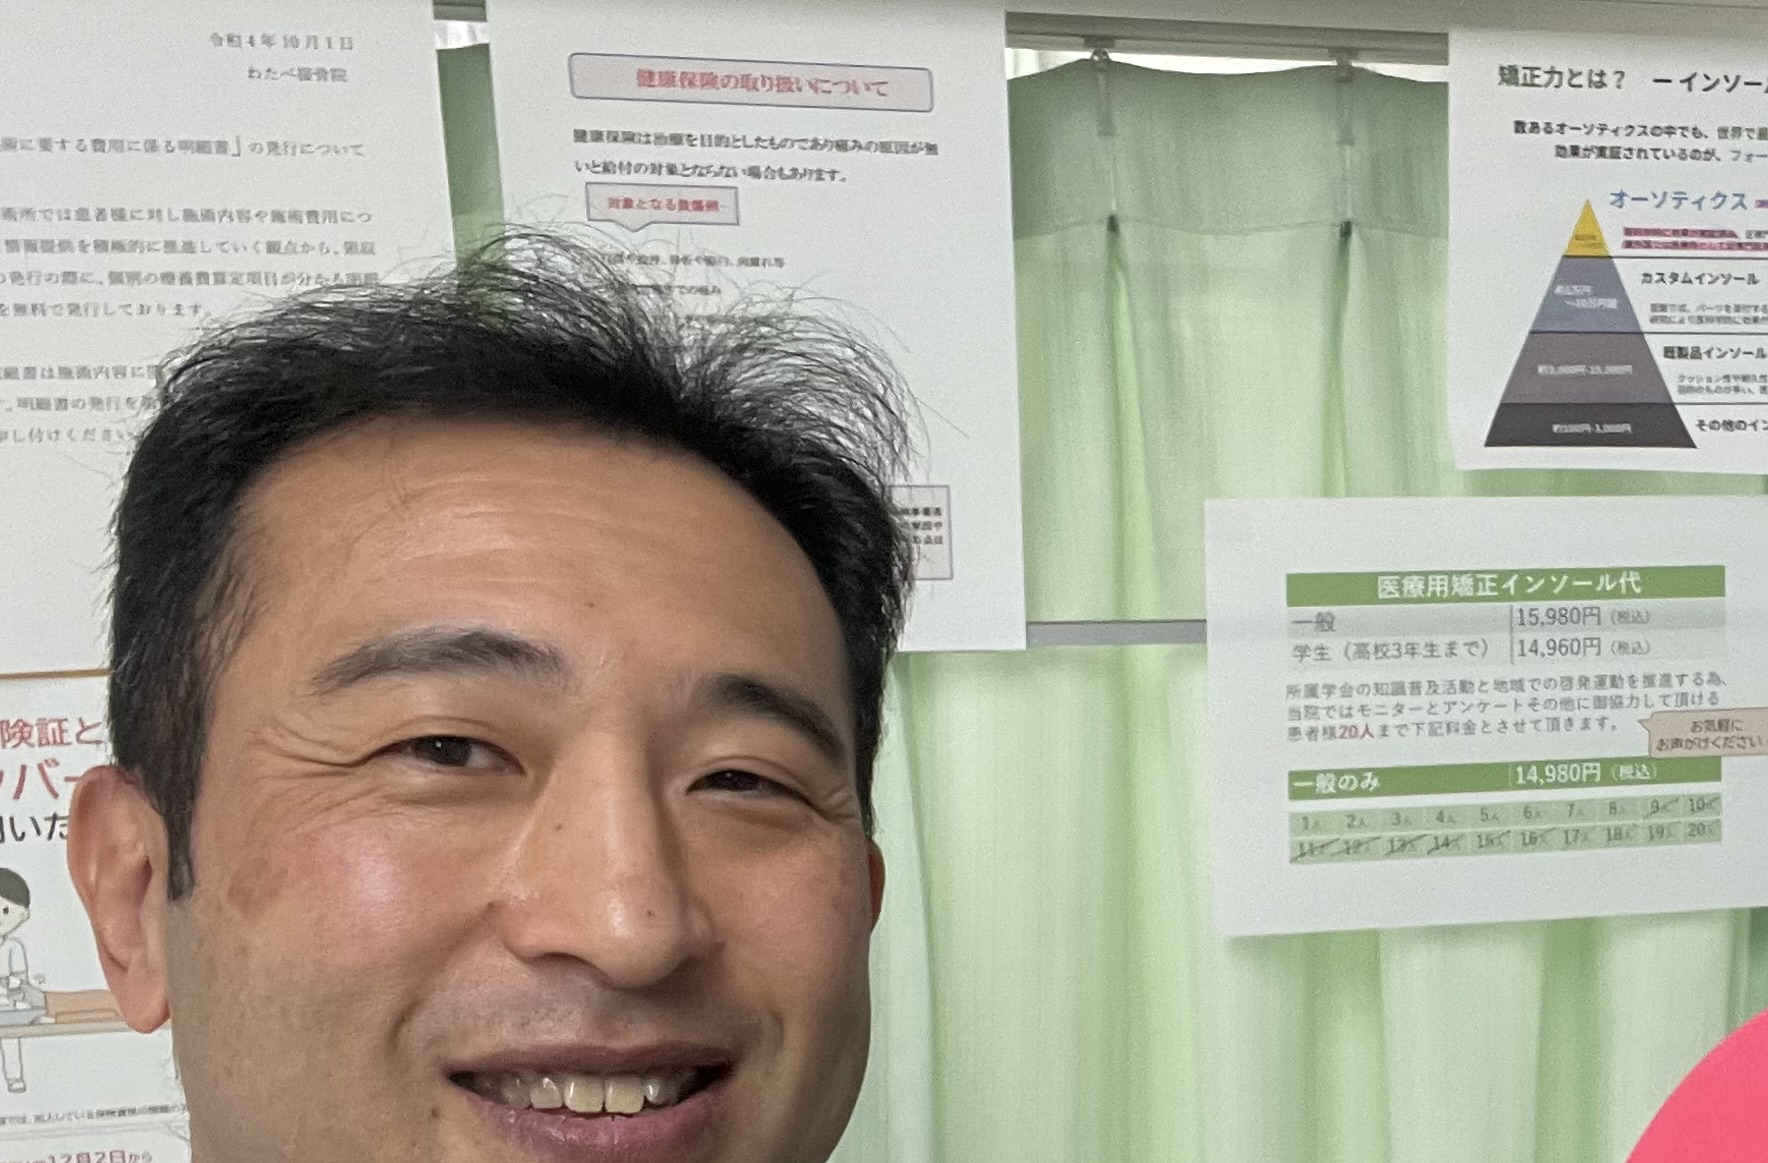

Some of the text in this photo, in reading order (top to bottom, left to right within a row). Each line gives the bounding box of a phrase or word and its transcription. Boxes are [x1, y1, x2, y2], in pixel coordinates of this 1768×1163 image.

[637, 68, 889, 97] 健康保険の取り扱いについて
[1609, 190, 1748, 210] オーソティクス
[1641, 272, 1759, 286] カスタムインソール
[1377, 570, 1643, 600] 医療用矯正インソール代
[1291, 611, 1335, 632] 一般
[1517, 637, 1601, 657] 14,960円
[0, 717, 104, 748] 険証と
[1690, 718, 1745, 733] お気軽に
[1293, 771, 1381, 794] 一般のみ
[1516, 762, 1600, 786] 14,980円
[0, 812, 68, 843] いた
